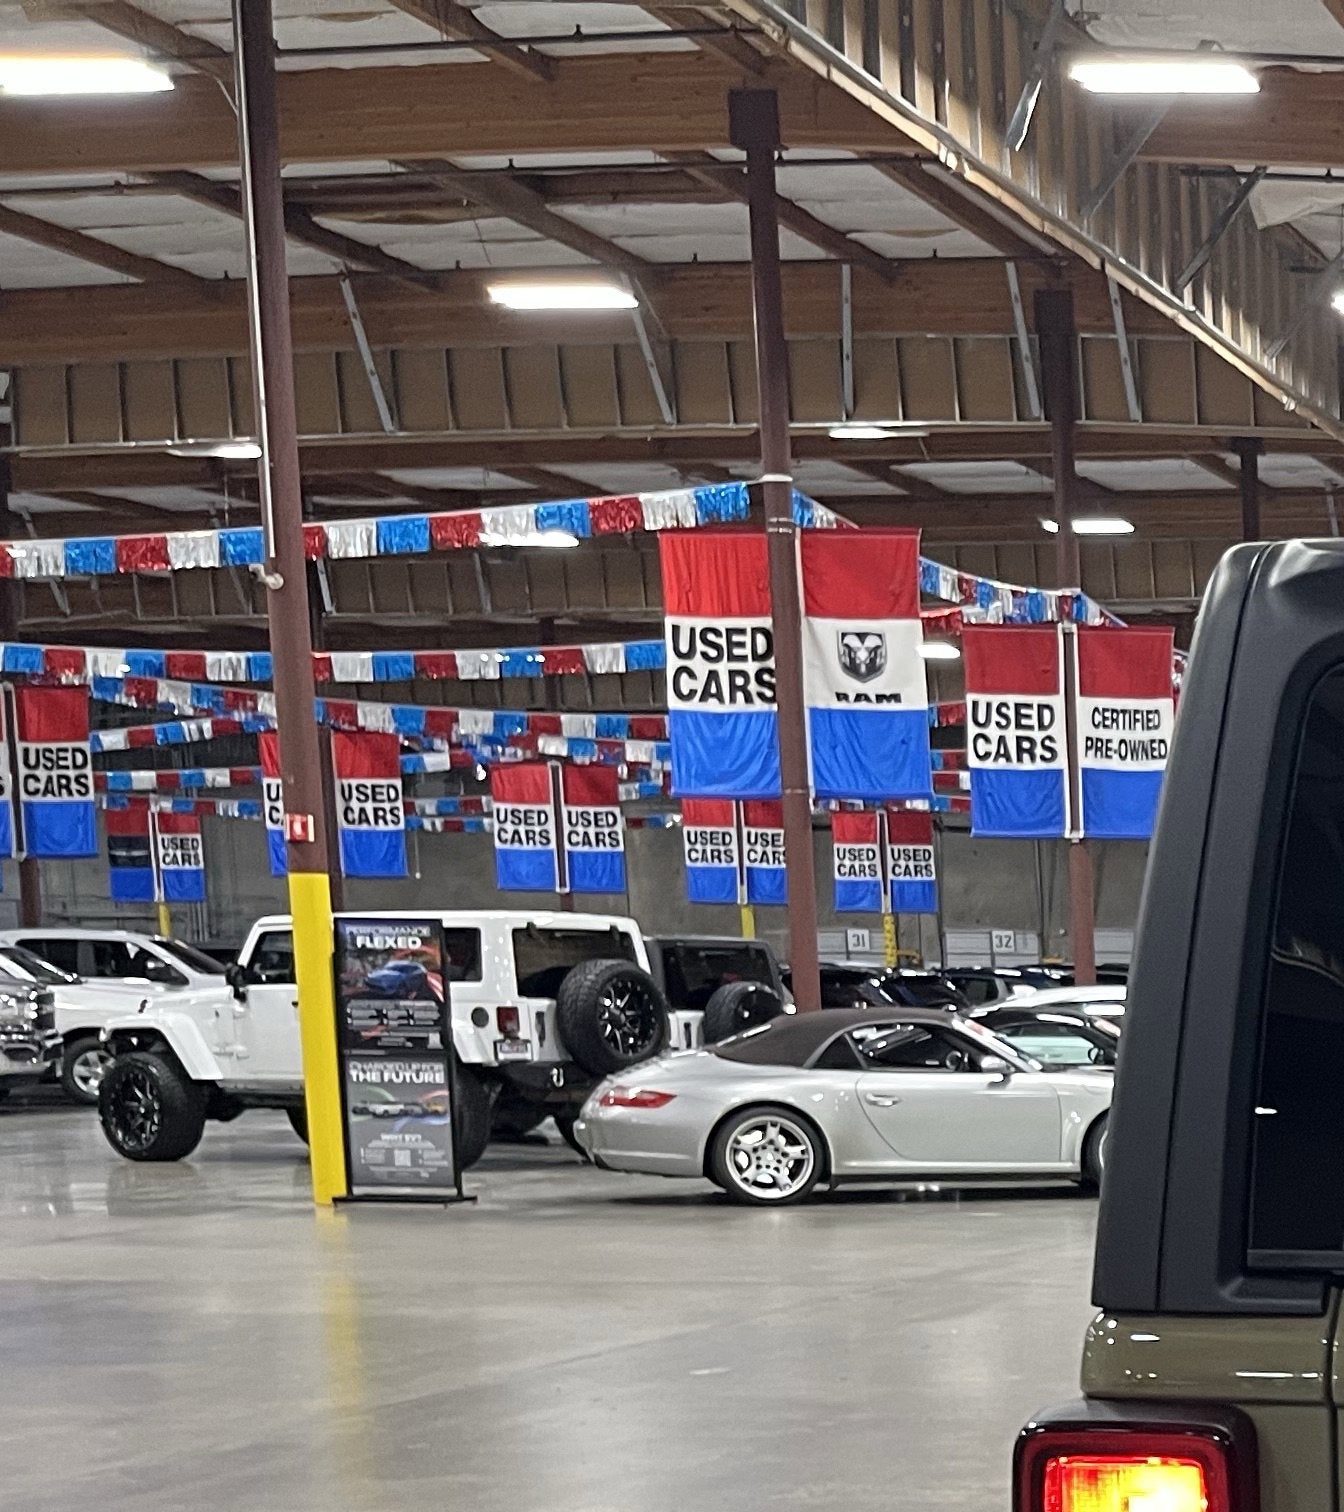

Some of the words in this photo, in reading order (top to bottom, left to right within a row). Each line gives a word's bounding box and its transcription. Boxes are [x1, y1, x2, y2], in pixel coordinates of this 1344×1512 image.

[671, 624, 773, 664] USED
[672, 665, 776, 705] CARS
[834, 692, 902, 704] RAM
[971, 700, 1055, 732] USED
[1091, 706, 1161, 731] CERTIFIED
[972, 732, 1058, 764] CARS
[1085, 736, 1168, 761] PRE-OWNED
[22, 747, 88, 771] USED
[23, 773, 90, 797] CARS
[341, 783, 399, 803] USED
[343, 806, 401, 826] CARS
[496, 808, 549, 826] USED
[567, 810, 618, 828] USED
[161, 837, 199, 851] USED
[497, 828, 551, 846] CARS
[568, 830, 620, 848] CARS
[687, 830, 732, 846] USED
[746, 831, 782, 848] USE
[162, 853, 201, 866] CARS
[687, 848, 734, 864] CARS
[837, 848, 876, 862] USED
[891, 848, 932, 862] USED
[837, 863, 877, 877] CARS
[892, 864, 933, 878] CARS
[994, 934, 1012, 949] 32
